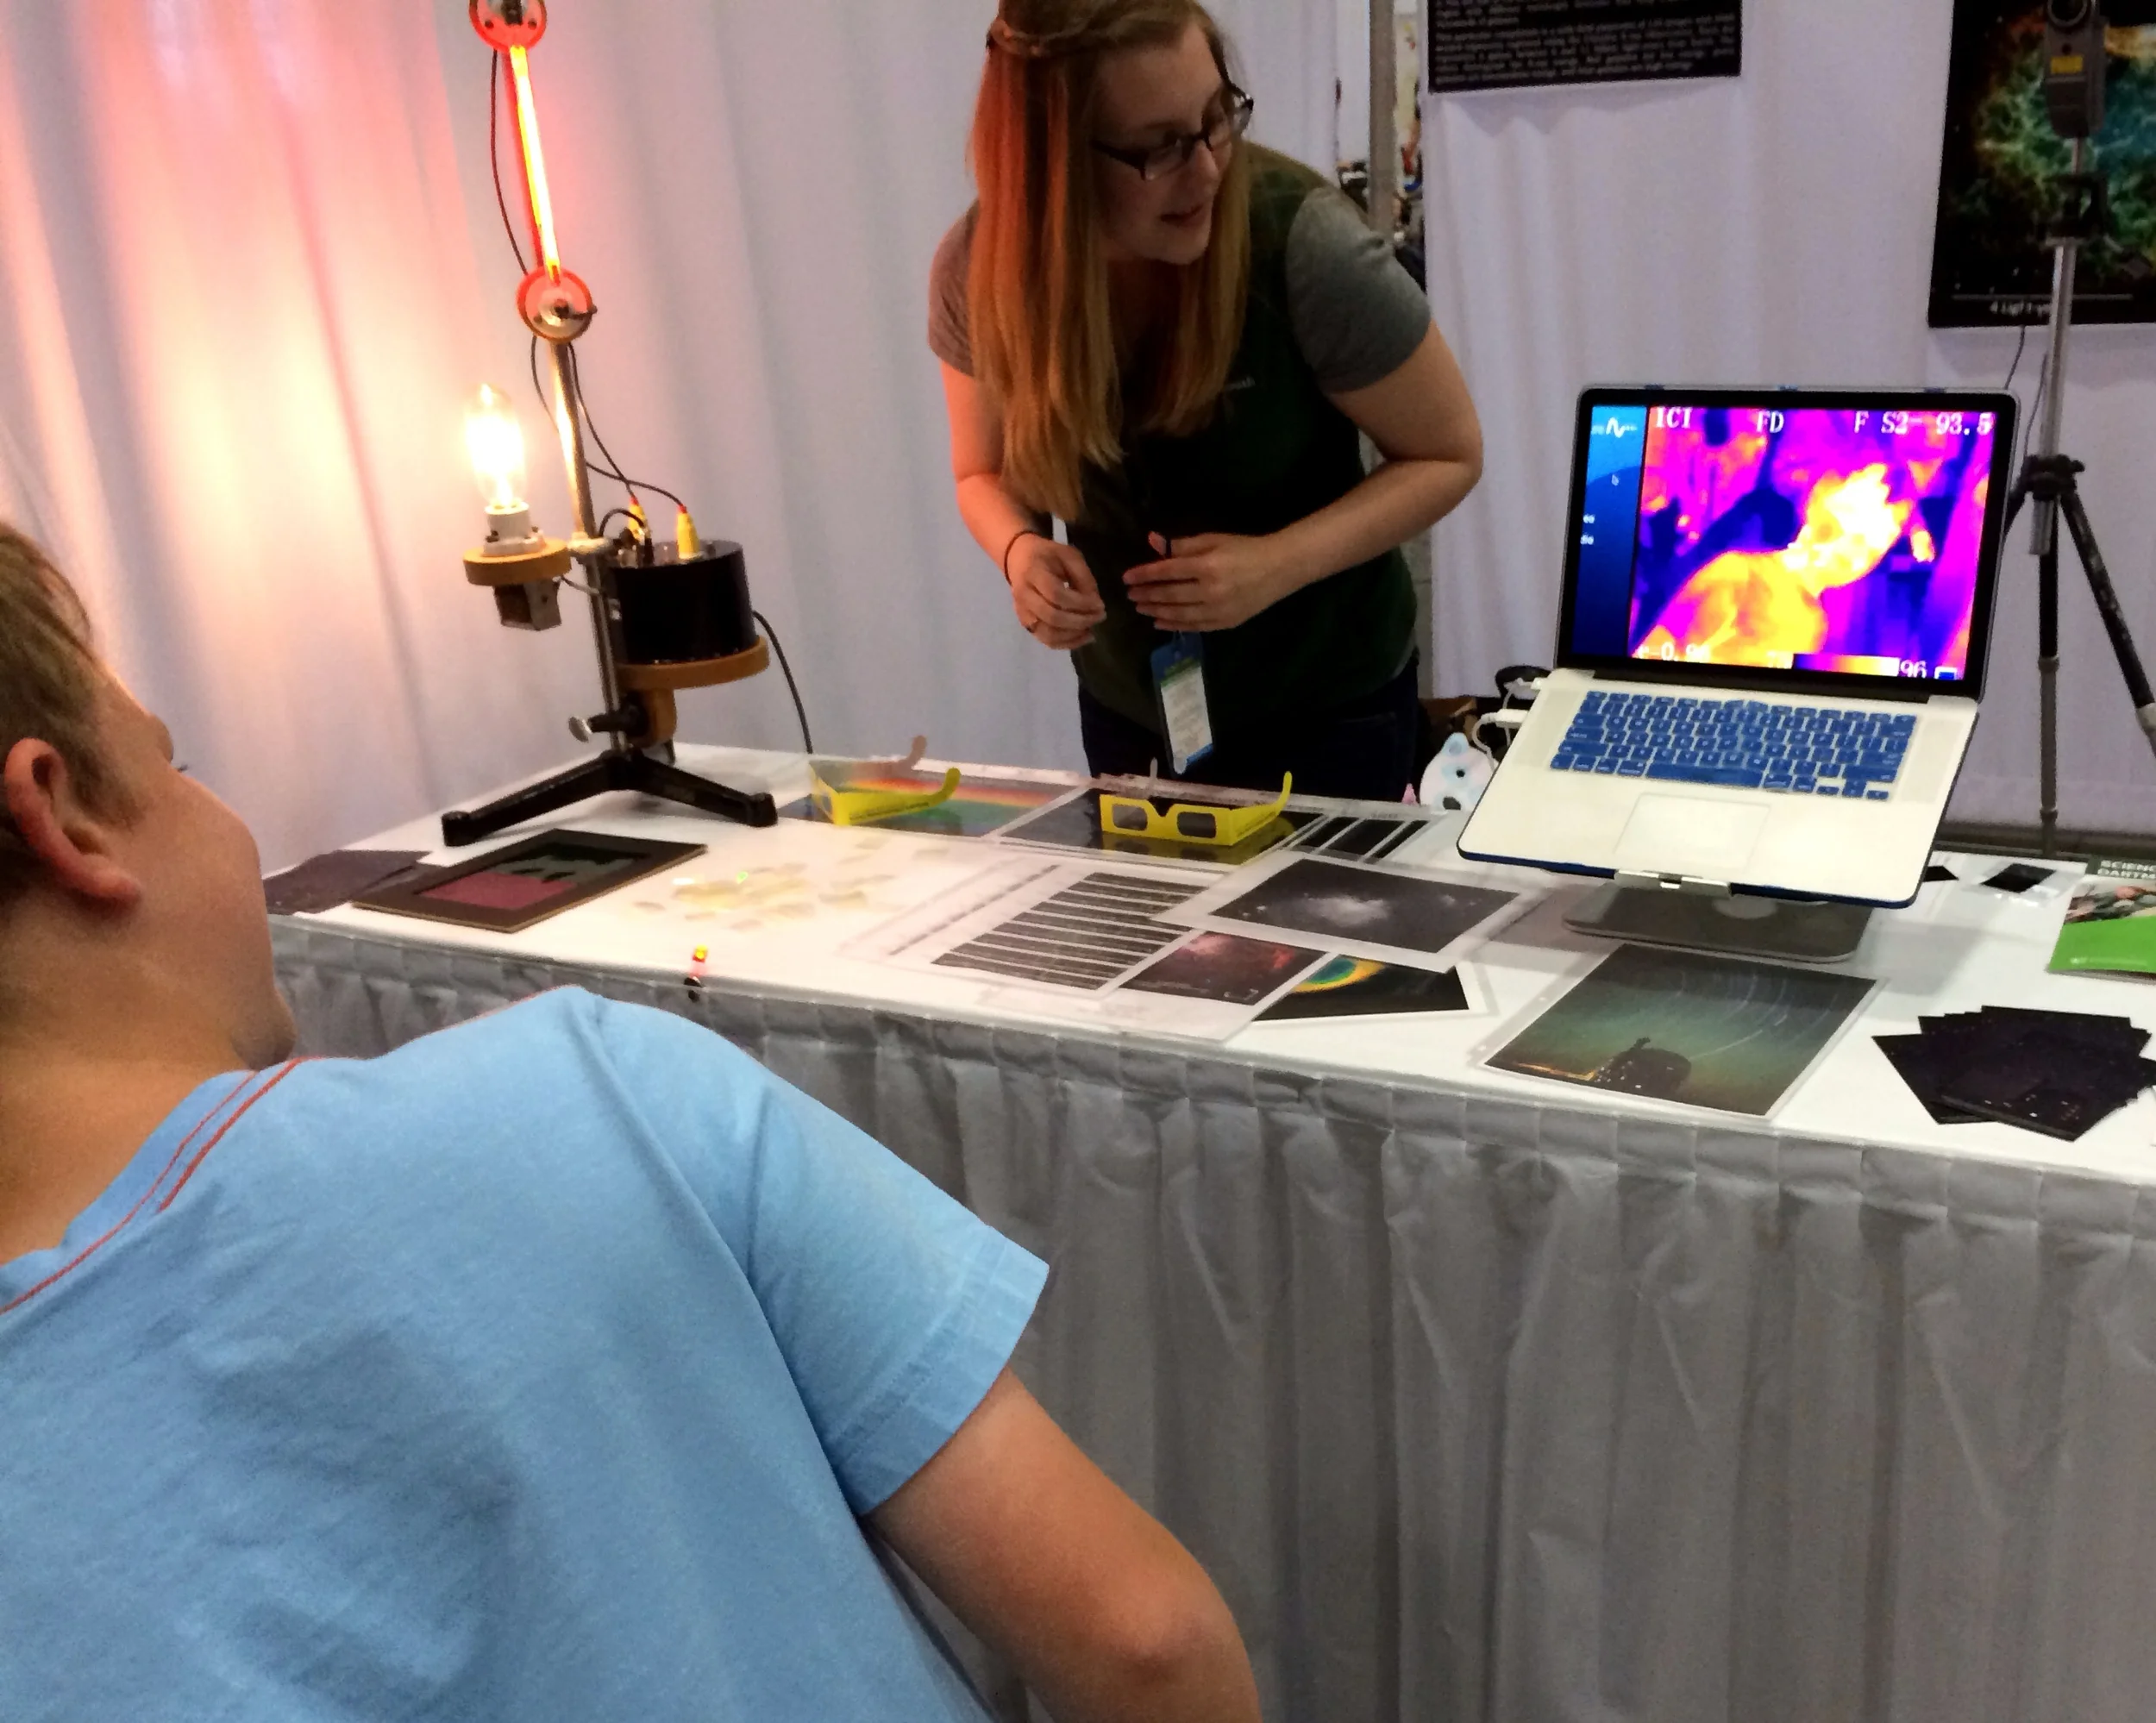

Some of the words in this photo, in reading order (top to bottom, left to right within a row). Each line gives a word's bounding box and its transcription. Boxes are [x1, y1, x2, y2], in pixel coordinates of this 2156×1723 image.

[1656, 407, 1692, 429] ICI
[1757, 410, 1784, 433] FD
[1854, 410, 1870, 433] F
